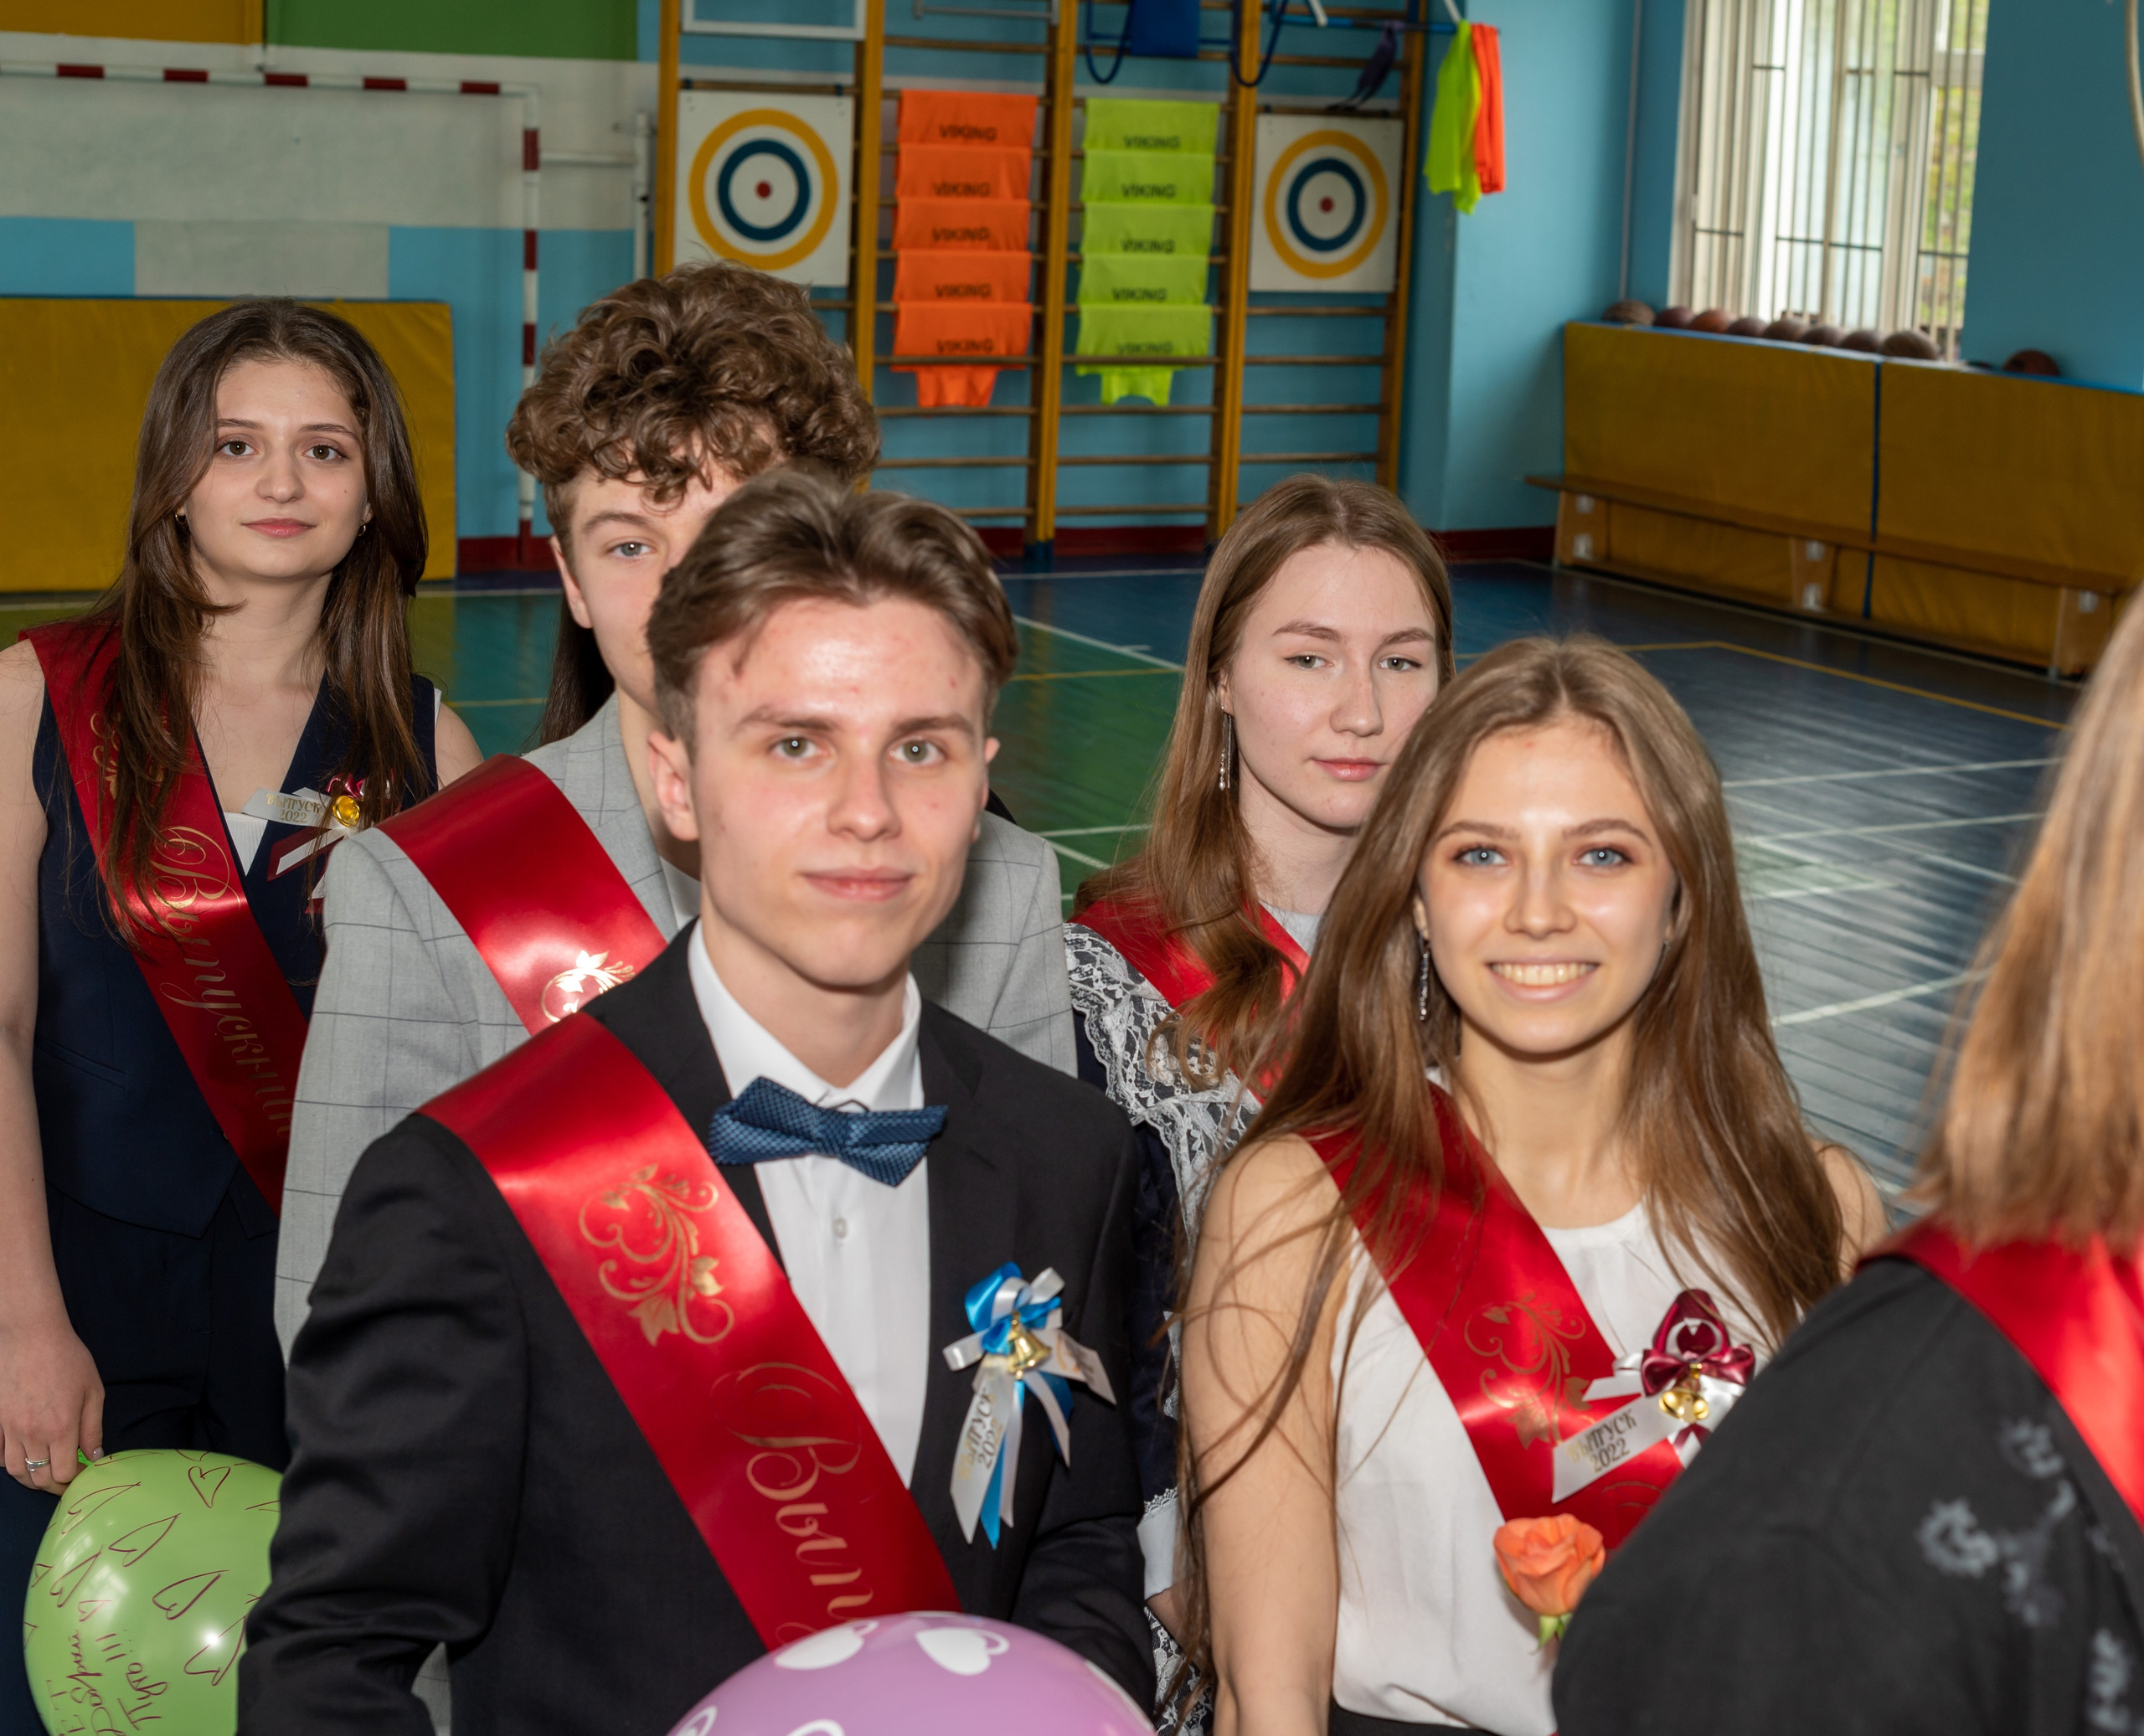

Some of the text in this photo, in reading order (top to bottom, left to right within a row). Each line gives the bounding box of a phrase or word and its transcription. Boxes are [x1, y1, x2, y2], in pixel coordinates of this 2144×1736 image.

[939, 124, 997, 142] VIKING
[1123, 135, 1181, 149] VIKING
[933, 181, 990, 197] VIKING
[1121, 183, 1176, 198] VIKING
[932, 226, 990, 242] VIKING
[1121, 238, 1175, 254] VIKING
[934, 283, 992, 299] VIKING
[1111, 287, 1167, 302] VIKING
[936, 338, 994, 354] VIKING
[265, 792, 322, 814] ВЫПУСК
[278, 808, 308, 823] 2022
[977, 1417, 1003, 1469] 2022
[1589, 1438, 1630, 1473] 2022
